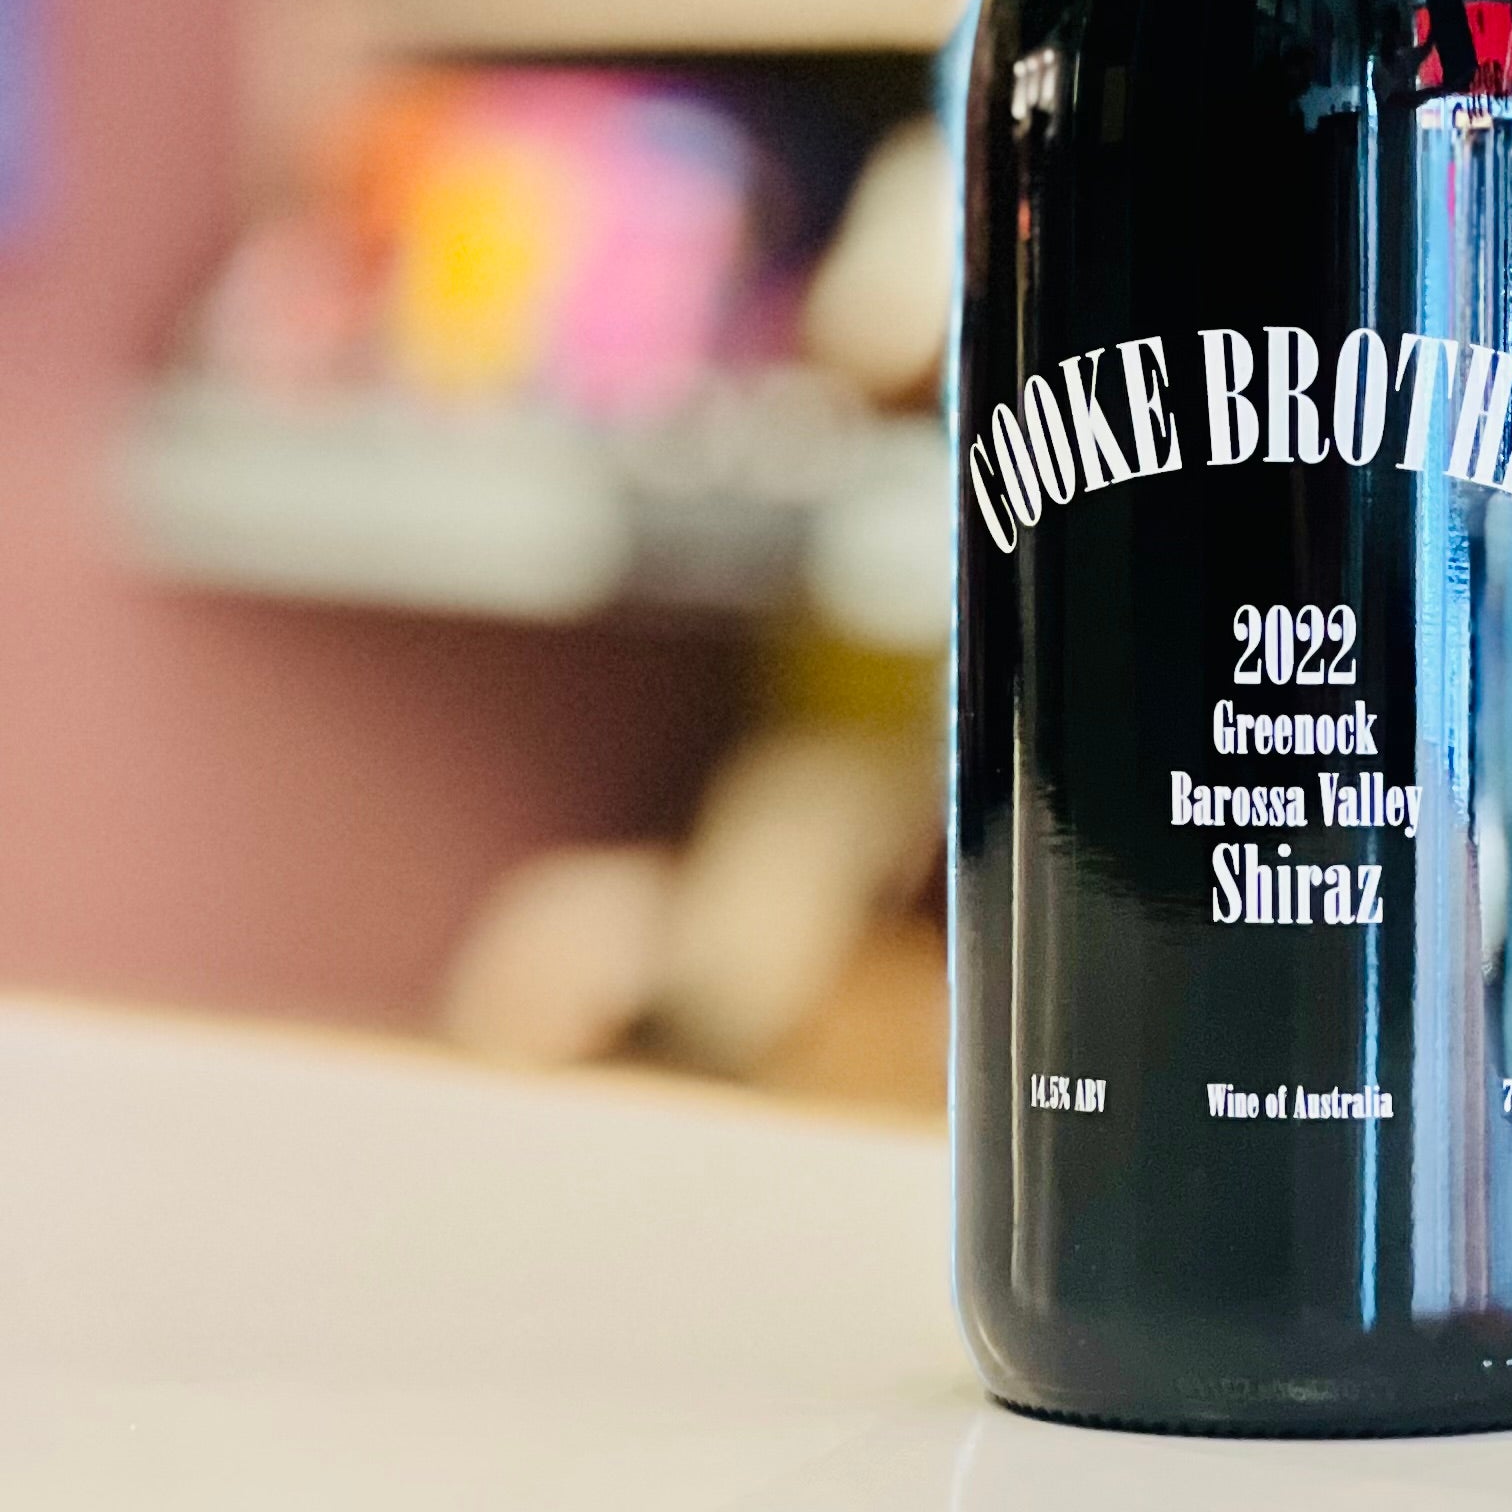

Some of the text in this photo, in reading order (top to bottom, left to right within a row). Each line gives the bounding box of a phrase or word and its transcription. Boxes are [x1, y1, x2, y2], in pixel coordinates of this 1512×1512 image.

[969, 336, 1182, 554] COOKE
[1233, 604, 1357, 686] 2022
[1212, 698, 1379, 755] Greenock
[1170, 770, 1423, 838] Barossa Valley
[1211, 842, 1384, 925] Shiraz
[1030, 1074, 1107, 1113] 14.5% ABV
[1207, 1083, 1394, 1119] Wine of Australia
